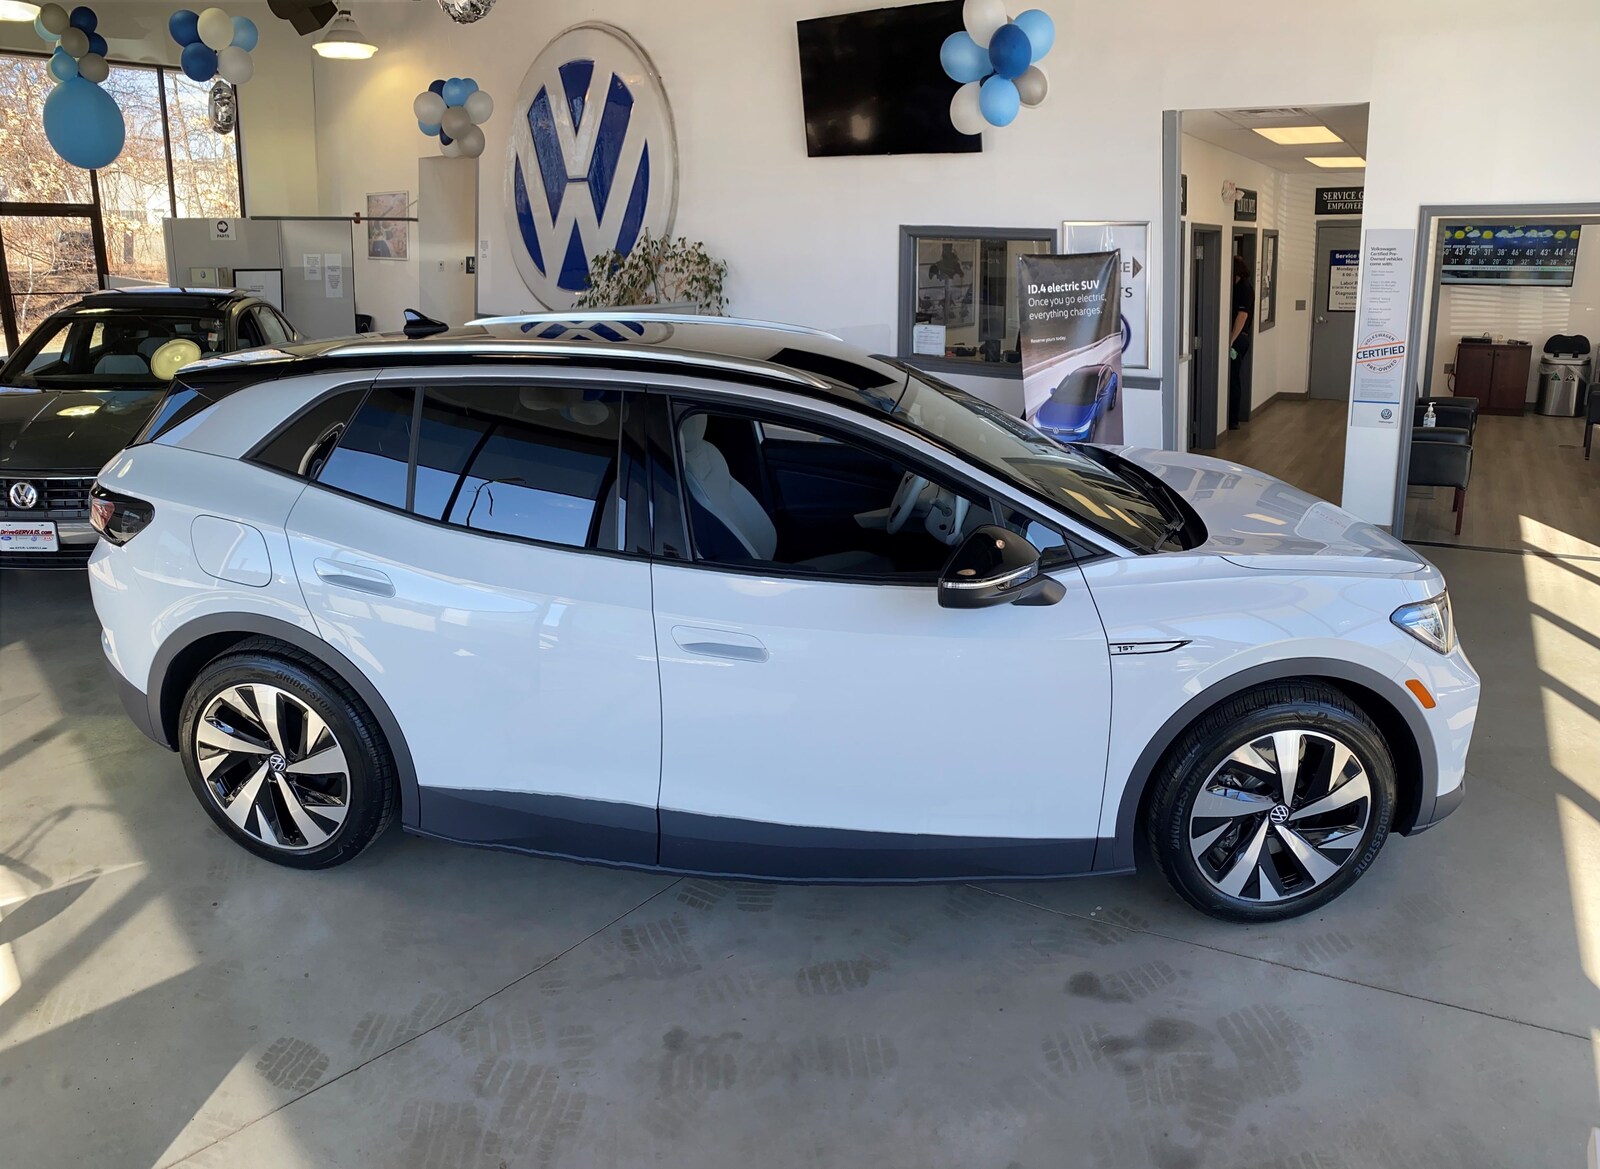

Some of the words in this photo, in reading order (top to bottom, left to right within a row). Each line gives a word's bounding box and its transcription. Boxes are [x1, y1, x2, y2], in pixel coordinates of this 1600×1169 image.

[1323, 191, 1356, 200] SERVICE
[1028, 284, 1046, 294] ID.4
[1047, 281, 1079, 293] electric
[1081, 280, 1100, 290] SUV
[1028, 297, 1049, 307] Once
[1050, 298, 1064, 310] you
[1065, 297, 1075, 307] go
[1029, 308, 1069, 321] everything
[1070, 306, 1103, 318] charges.
[1364, 332, 1395, 345] VOLKSWAGEN
[1356, 345, 1405, 360] CERTIFIED
[1366, 359, 1397, 372] PRE-OWNED
